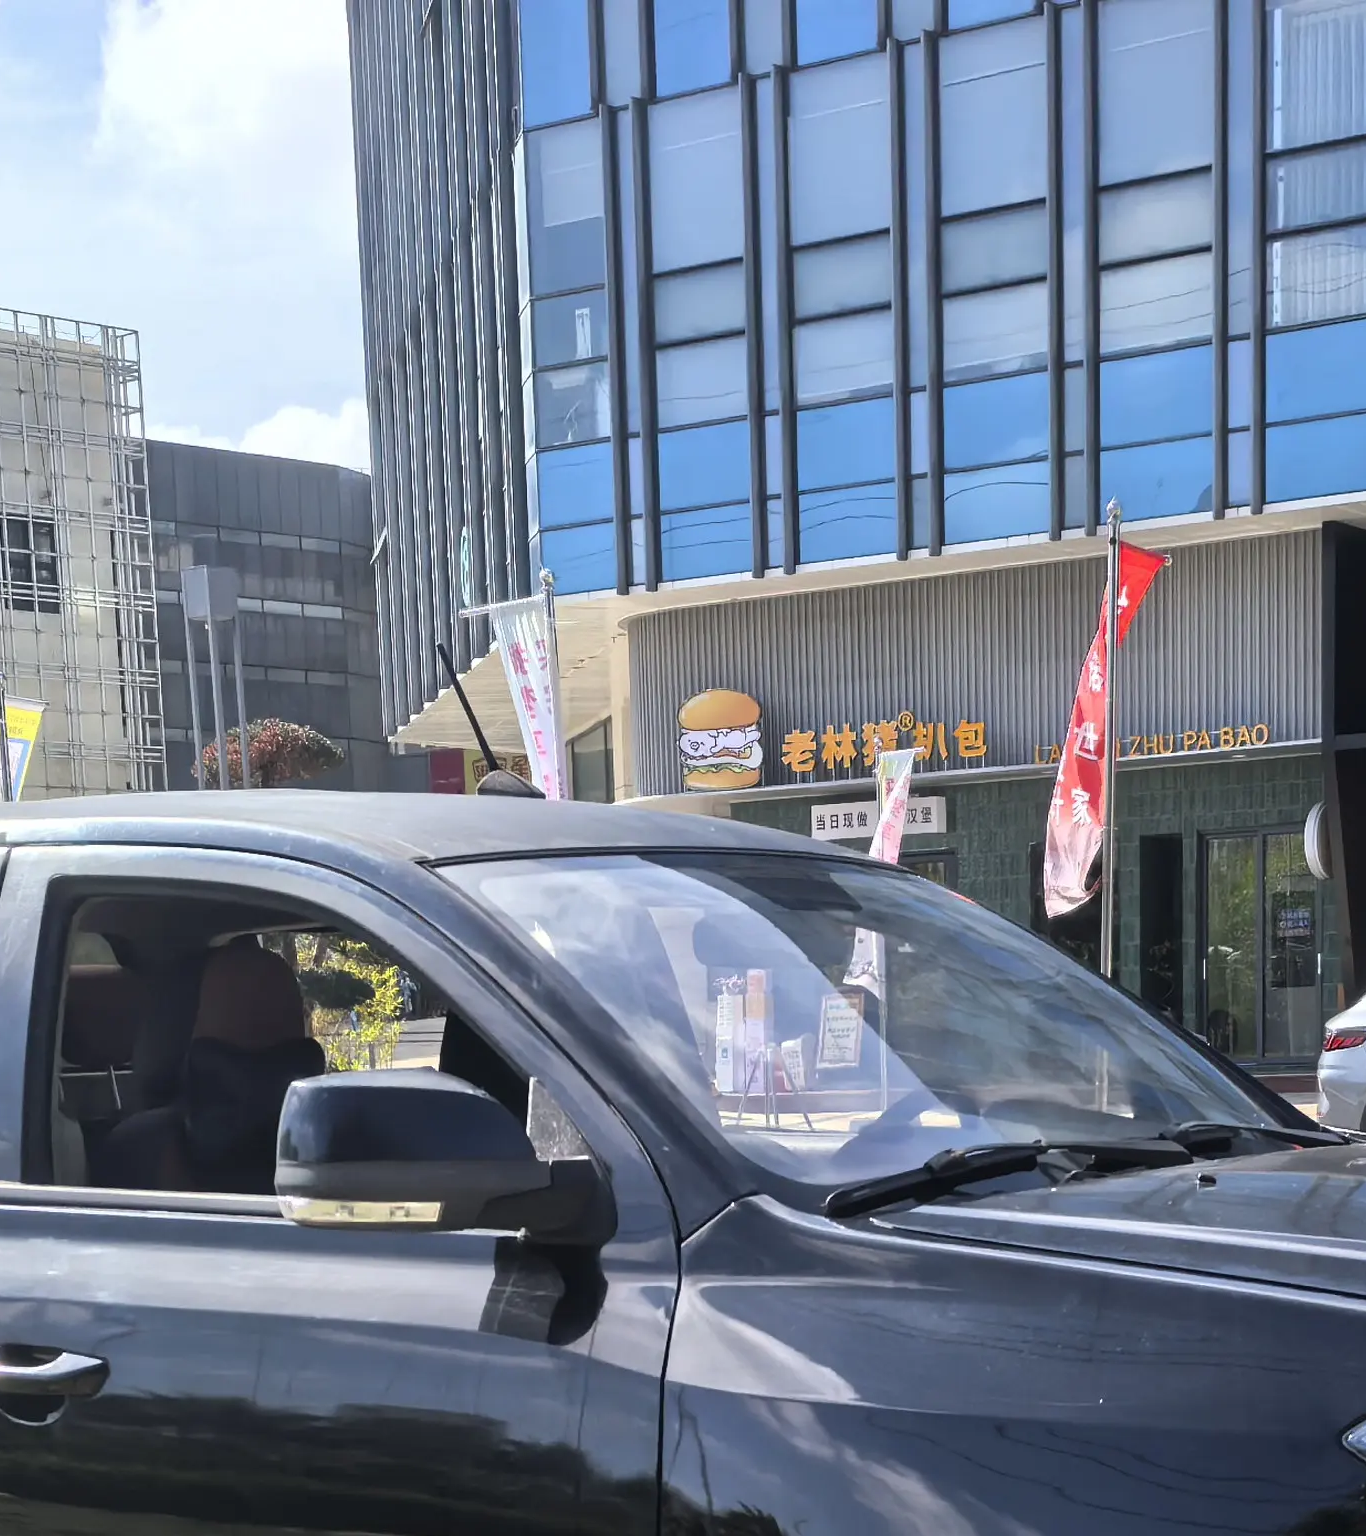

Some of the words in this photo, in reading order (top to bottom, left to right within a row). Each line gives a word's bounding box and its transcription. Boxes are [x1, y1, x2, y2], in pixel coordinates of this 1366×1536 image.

[1129, 733, 1175, 756] ZHU
[1183, 730, 1212, 752] PA
[1220, 723, 1270, 748] BAO
[815, 810, 869, 831] 当日现做
